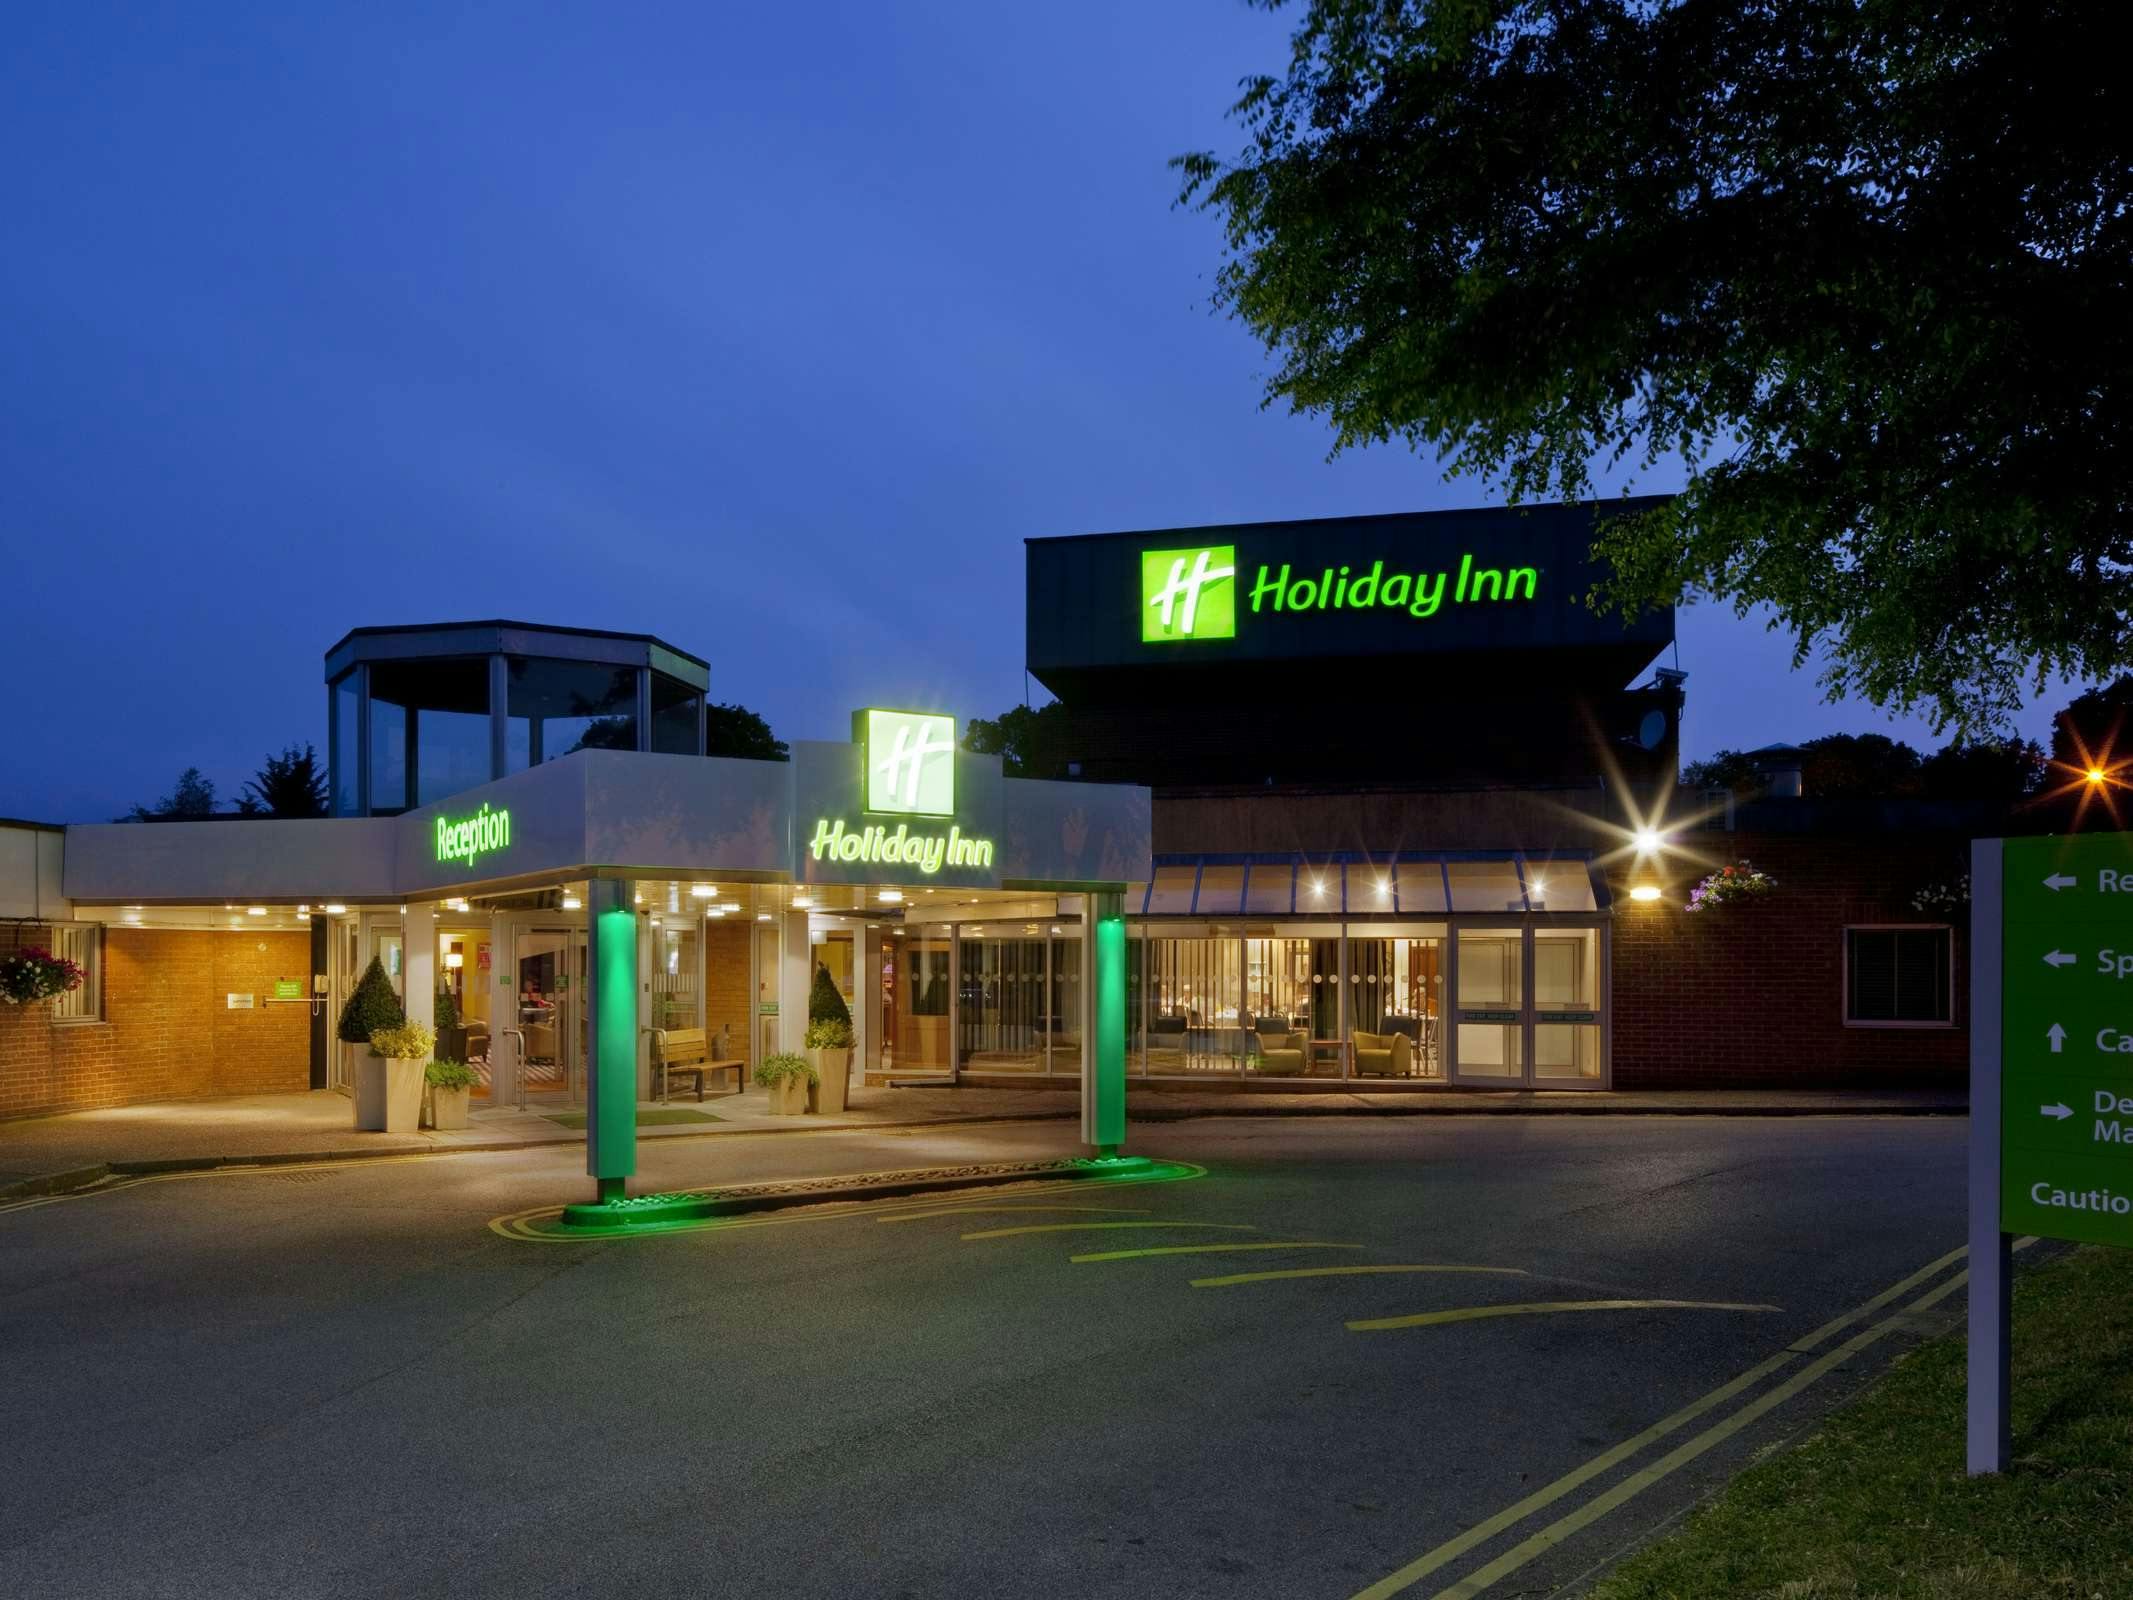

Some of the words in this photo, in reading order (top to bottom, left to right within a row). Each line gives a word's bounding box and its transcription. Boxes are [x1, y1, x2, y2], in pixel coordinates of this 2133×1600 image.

[1249, 561, 1447, 617] Holiday
[1456, 554, 1537, 602] Inn
[437, 802, 510, 867] Reception
[810, 819, 945, 873] Holiday
[946, 826, 993, 866] Inn
[2099, 869, 2133, 892] Re
[2097, 949, 2133, 979] Sp
[2096, 1028, 2133, 1052] Ca
[2094, 1090, 2133, 1114] De
[2093, 1119, 2133, 1144] Ma
[2031, 1182, 2133, 1213] Cautio
